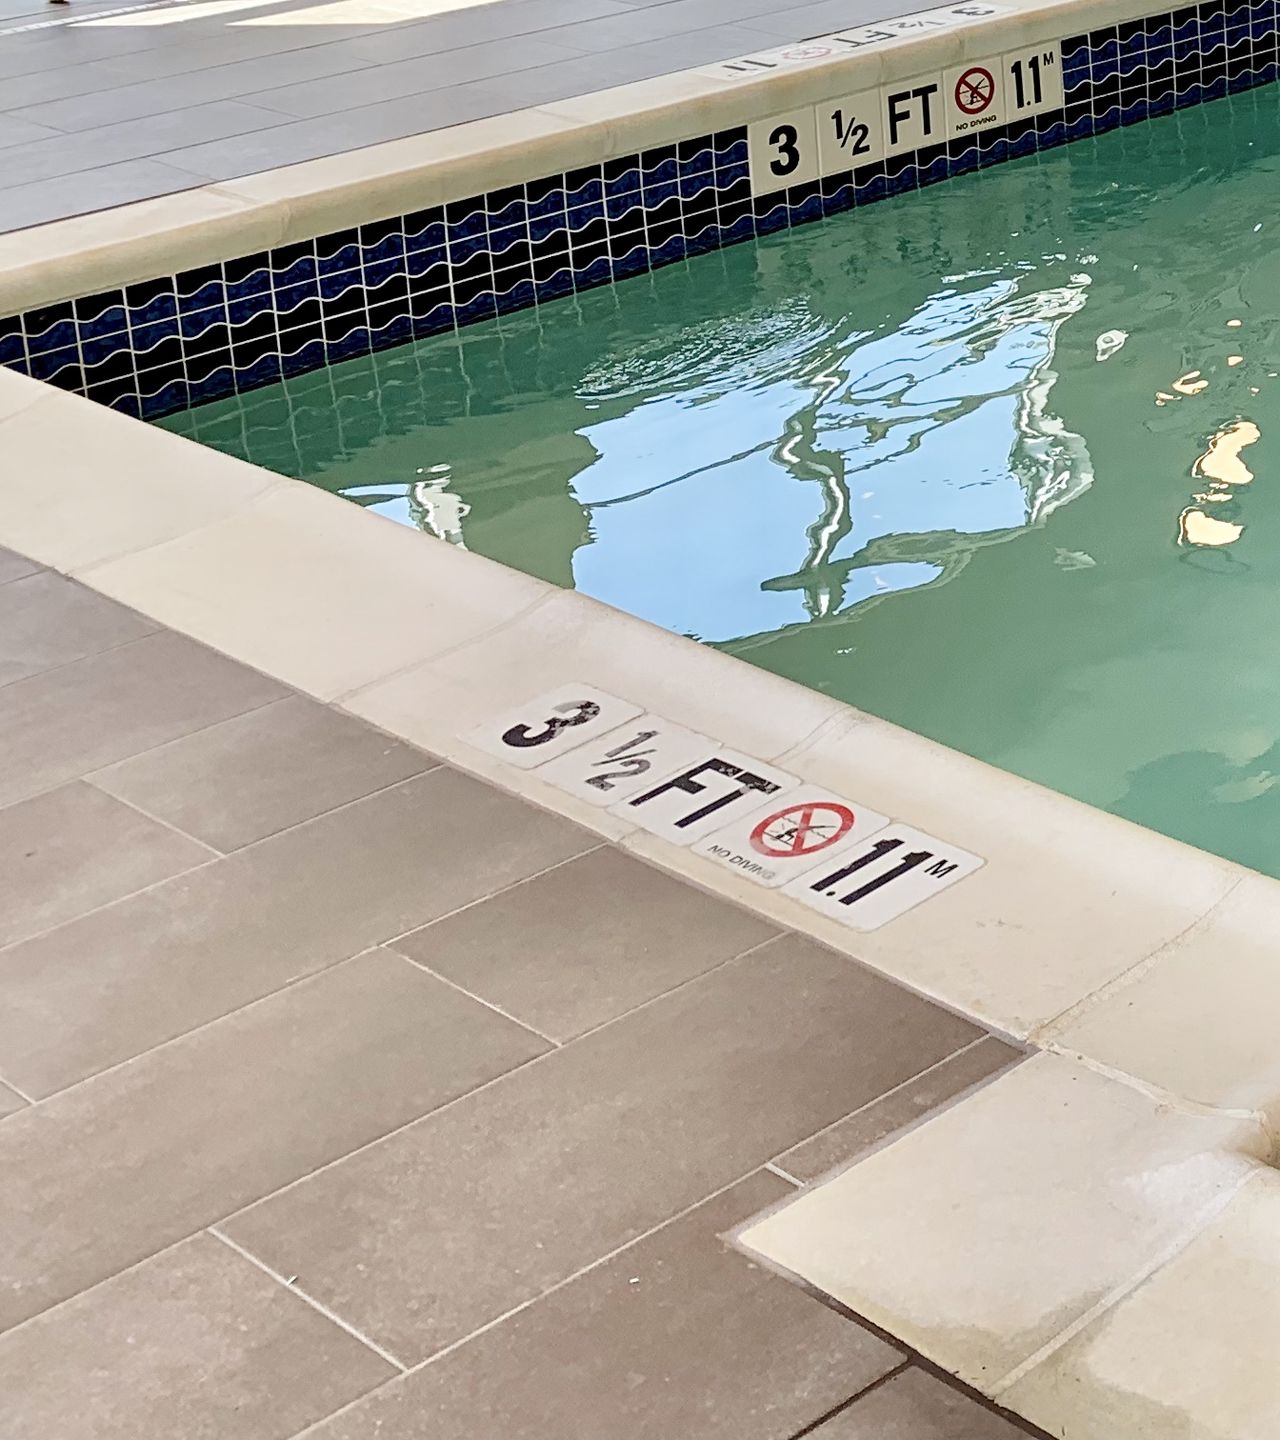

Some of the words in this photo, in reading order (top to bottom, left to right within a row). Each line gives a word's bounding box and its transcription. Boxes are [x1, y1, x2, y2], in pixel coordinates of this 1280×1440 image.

[768, 124, 800, 177] 3
[887, 83, 938, 145] FT
[956, 123, 968, 131] NO
[970, 114, 997, 127] DIVING
[501, 699, 601, 748] 3
[628, 757, 782, 828] FT
[707, 844, 731, 859] NO
[729, 855, 777, 880] DIVING
